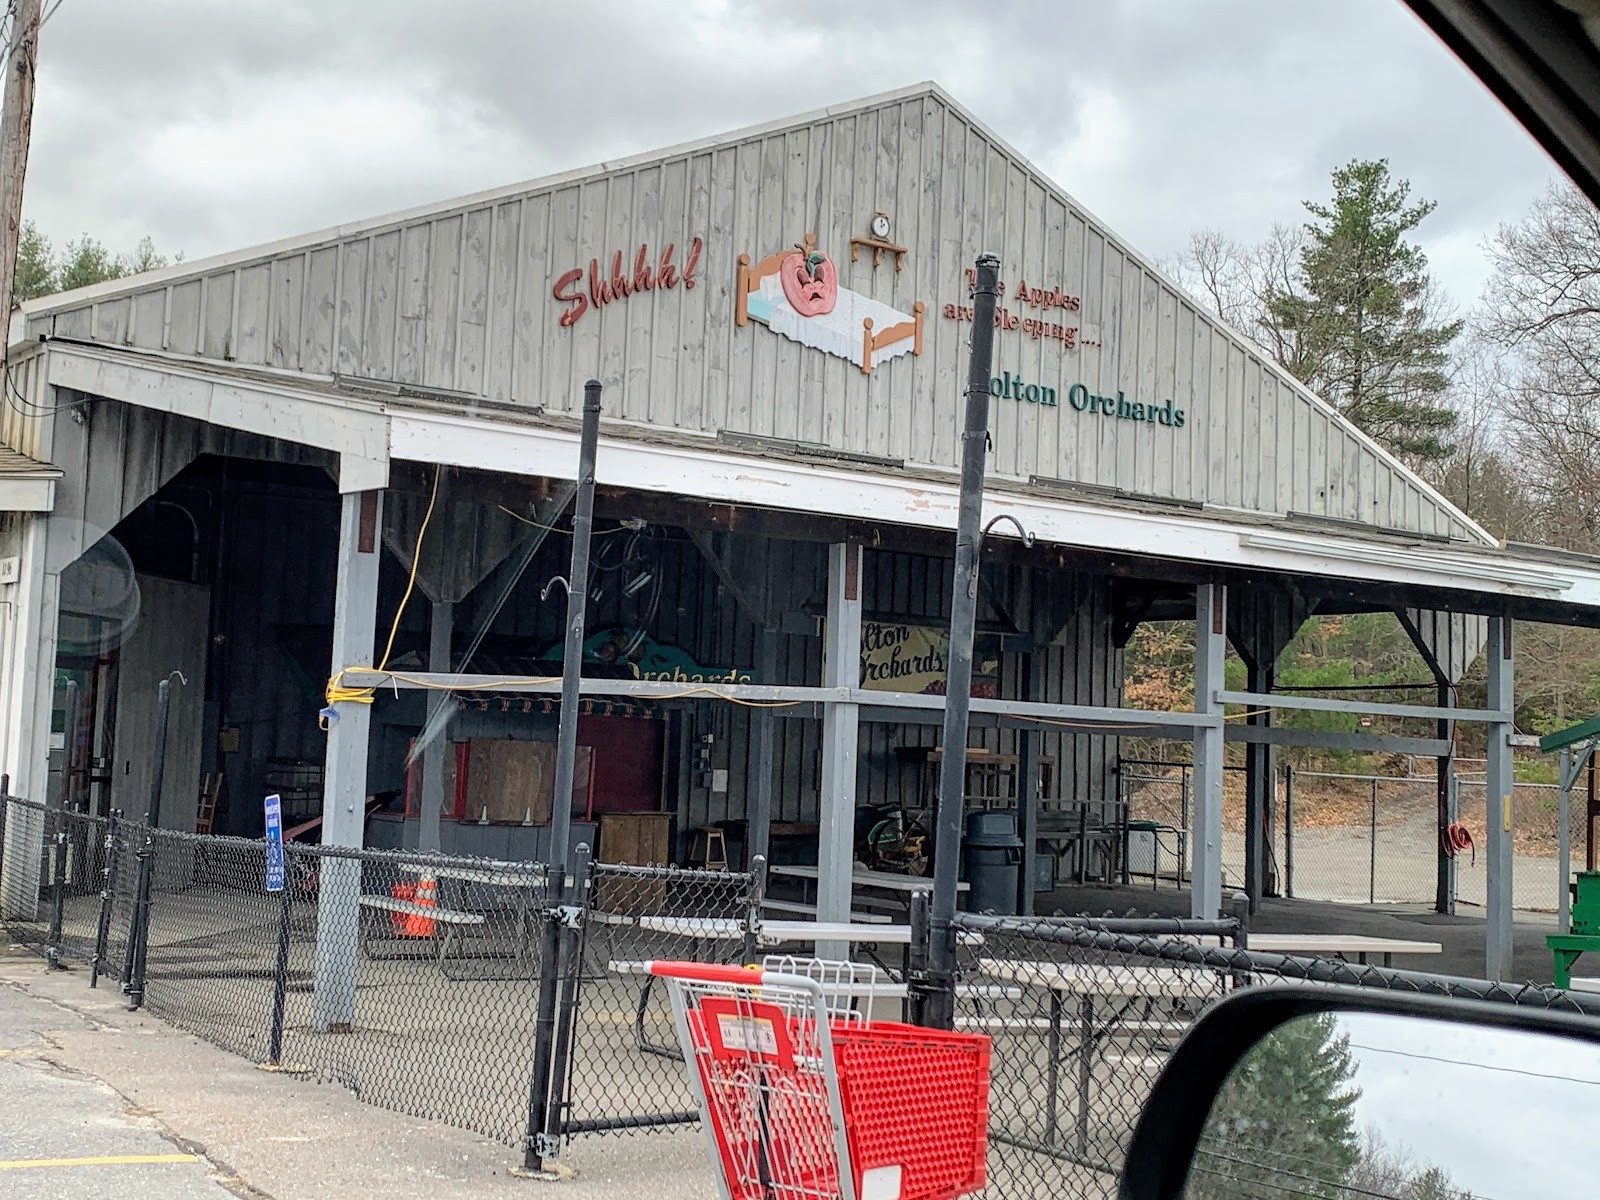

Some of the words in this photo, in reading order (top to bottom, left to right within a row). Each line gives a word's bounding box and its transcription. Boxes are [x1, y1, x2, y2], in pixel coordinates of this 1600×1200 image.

[553, 237, 703, 327] Shhhh!
[965, 267, 1006, 297] Te
[1014, 279, 1080, 312] Apples
[989, 370, 1057, 407] olton
[1069, 382, 1186, 428] Orchards
